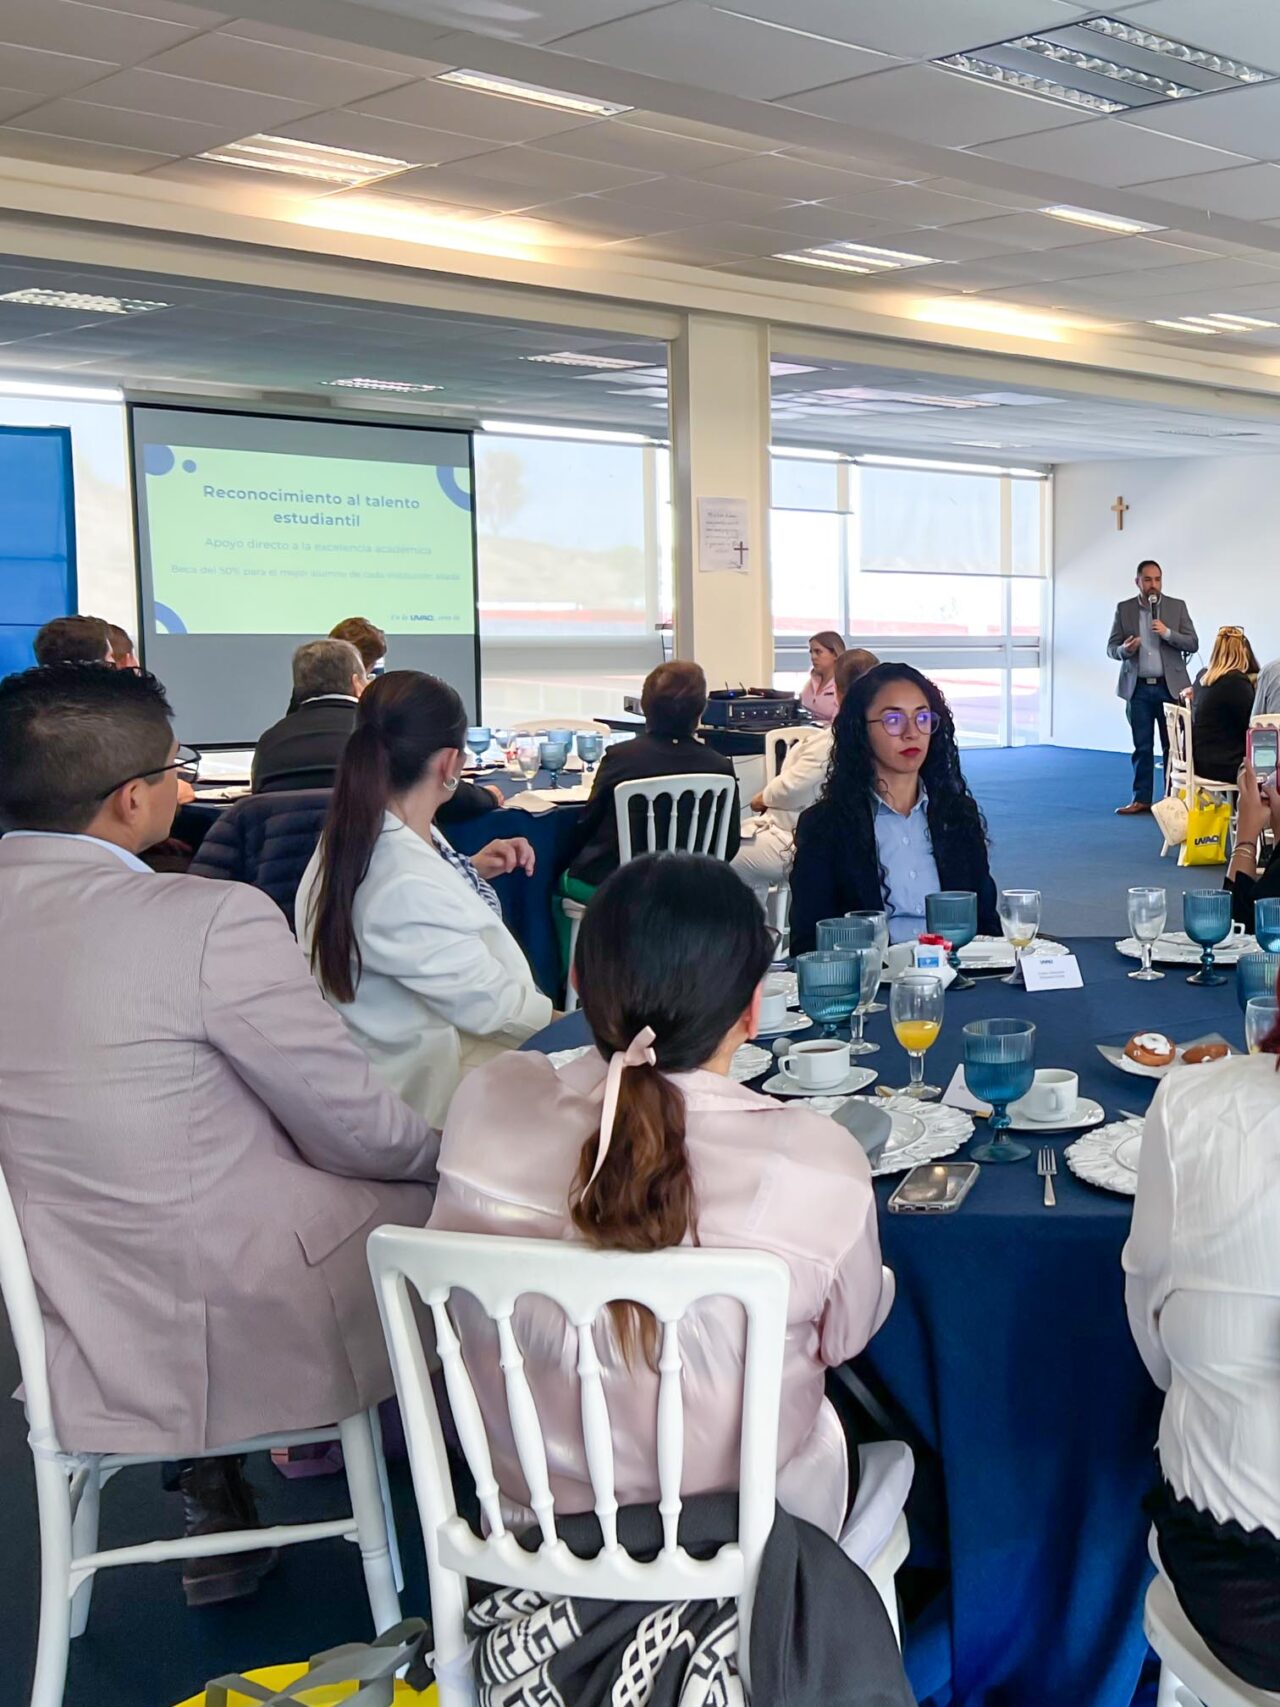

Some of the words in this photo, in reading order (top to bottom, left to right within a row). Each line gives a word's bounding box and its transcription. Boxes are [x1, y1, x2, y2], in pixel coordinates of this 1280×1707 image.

[203, 485, 342, 505] Reconocimiento
[347, 494, 360, 506] al
[366, 496, 420, 509] talento
[273, 513, 360, 527] estudiantil
[204, 537, 244, 550] Apoyo
[247, 538, 289, 550] directo
[302, 541, 311, 551] la
